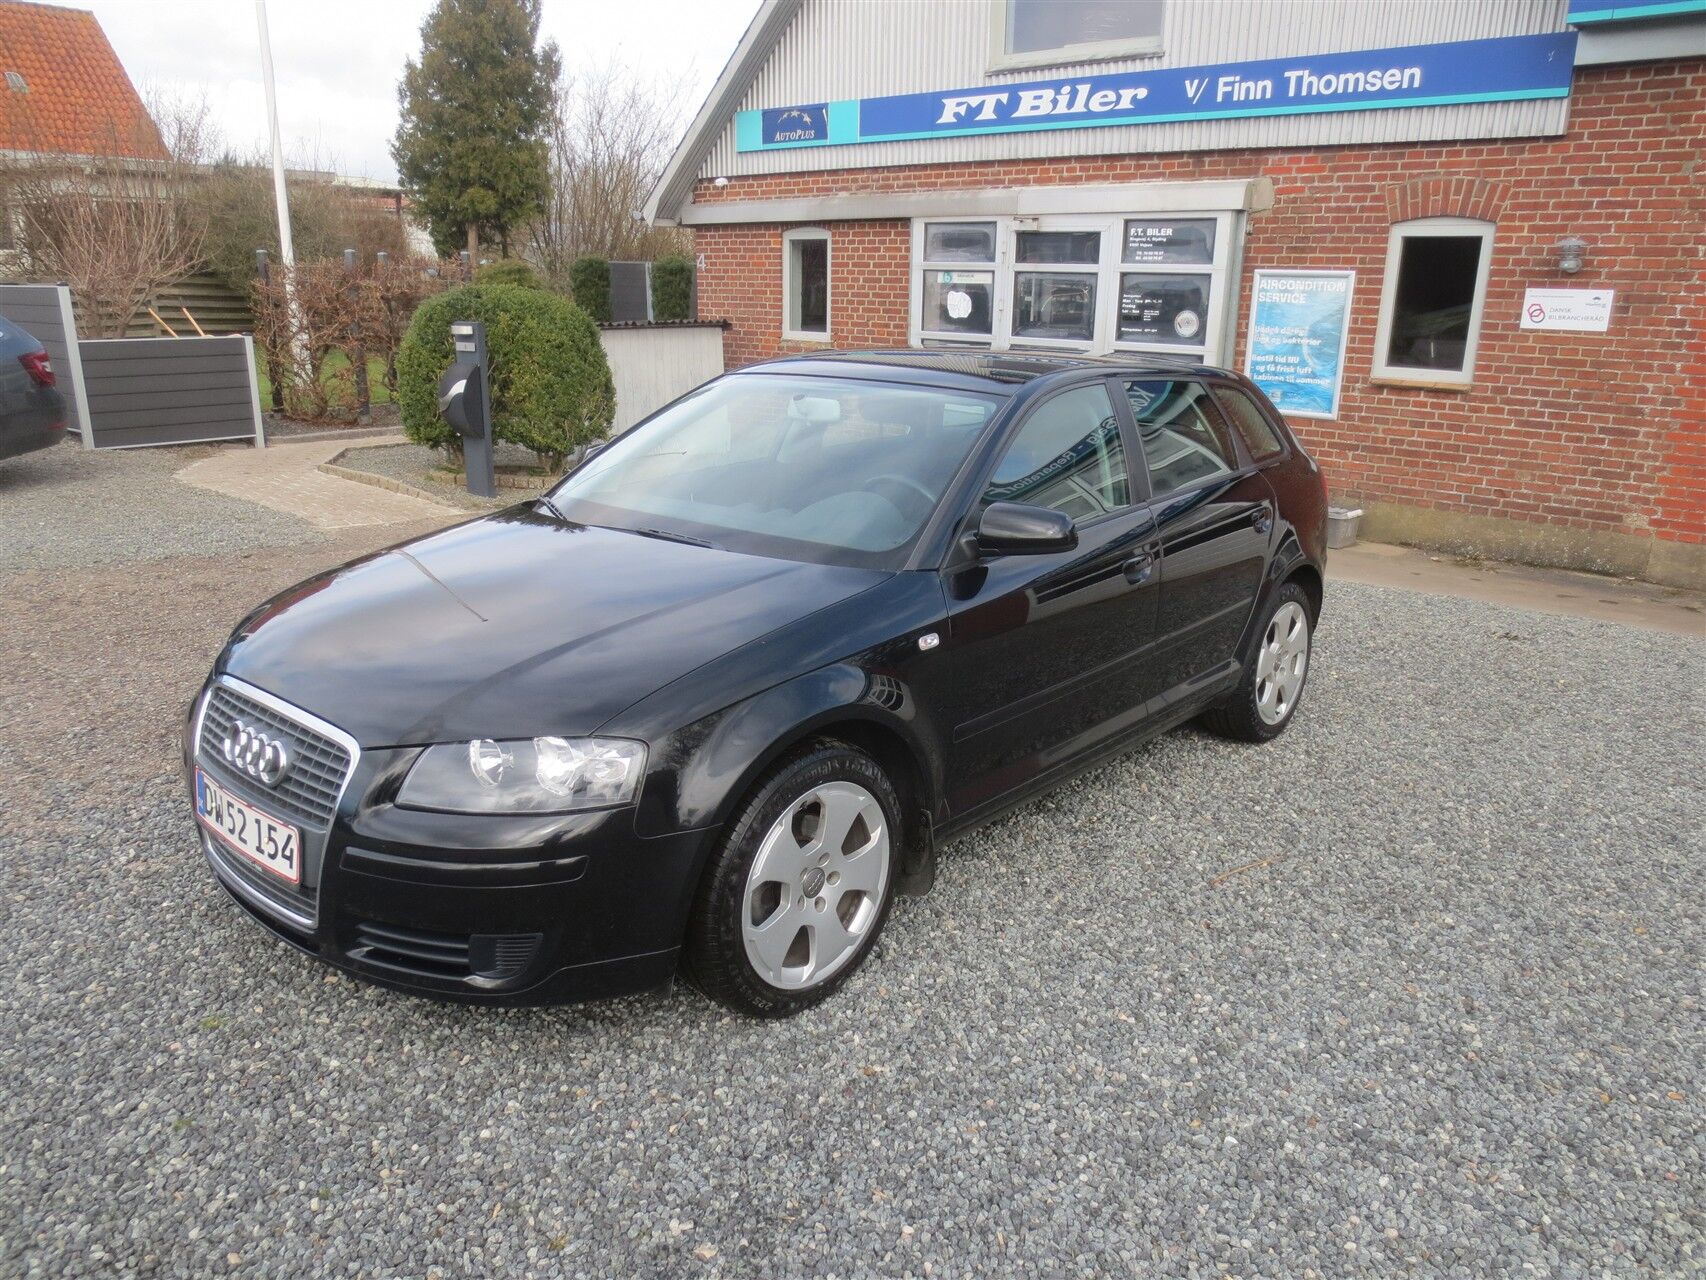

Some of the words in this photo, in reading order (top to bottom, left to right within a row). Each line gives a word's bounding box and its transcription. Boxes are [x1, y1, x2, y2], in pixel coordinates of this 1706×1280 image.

[1217, 76, 1272, 102] Finn
[1284, 66, 1421, 97] Thomsen
[936, 93, 1009, 124] FT
[1011, 84, 1148, 117] Biler
[1147, 228, 1173, 236] BILER
[697, 253, 706, 271] 4
[1259, 280, 1346, 292] AIRCONDITION
[1258, 292, 1307, 304] SERVICE
[205, 782, 223, 826] DW
[227, 800, 247, 846] 52
[255, 818, 294, 869] 154
